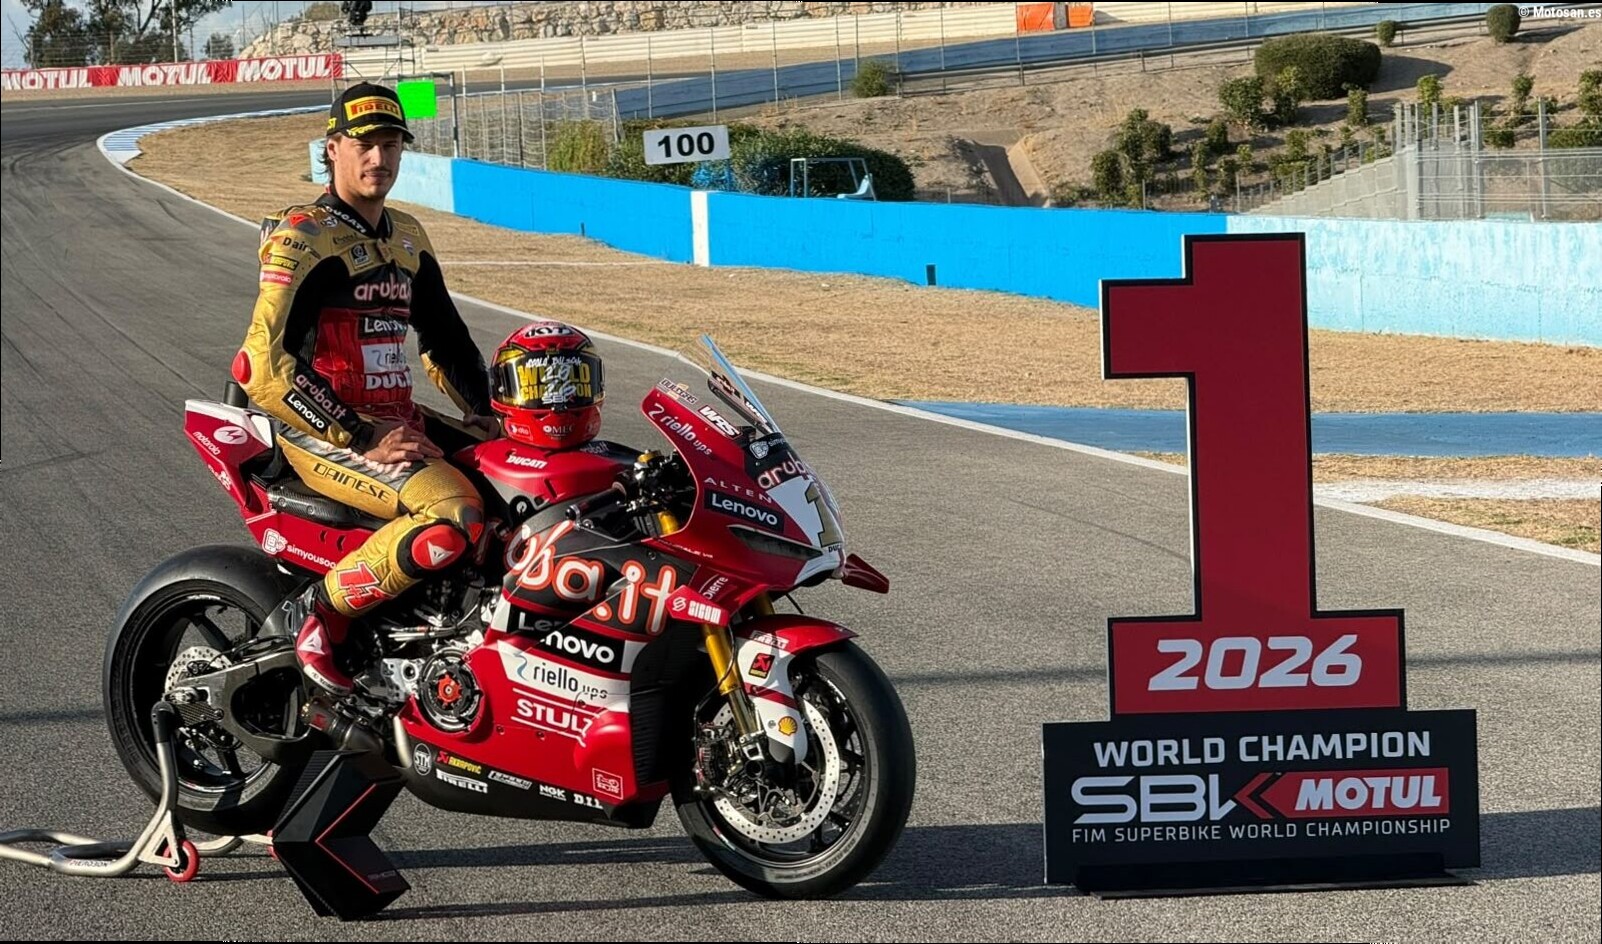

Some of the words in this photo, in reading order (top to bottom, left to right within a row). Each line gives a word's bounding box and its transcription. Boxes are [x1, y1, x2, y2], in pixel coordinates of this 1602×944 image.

[1, 68, 92, 90] MOTUL
[118, 62, 212, 87] MOTUL
[238, 55, 331, 82] MOTUL
[657, 131, 715, 158] 100
[325, 206, 367, 234] DUCATI
[287, 393, 325, 429] Lenovo
[295, 374, 347, 420] aruba.it
[660, 415, 697, 442] riello
[692, 437, 713, 455] ups
[699, 406, 741, 439] WRS
[192, 431, 222, 457] motorola
[506, 454, 548, 470] DUCATI
[313, 463, 392, 503] DAINESE
[704, 476, 773, 504] ALTEN
[711, 493, 779, 527] Lenovo
[286, 544, 337, 570] simyousoo
[1148, 634, 1363, 691] 2026
[533, 662, 579, 693] riello
[1093, 737, 1226, 768] WORLD
[1238, 730, 1431, 762] CHAMPION
[435, 768, 489, 794] PIRELLI
[539, 784, 566, 799] NGK
[1294, 775, 1442, 811] MOTUL
[1072, 829, 1107, 843] FIM
[1114, 825, 1222, 842] SUPERBIKE
[1229, 823, 1297, 839] WORLD
[1306, 819, 1451, 837] CHAMPIONSHIP
